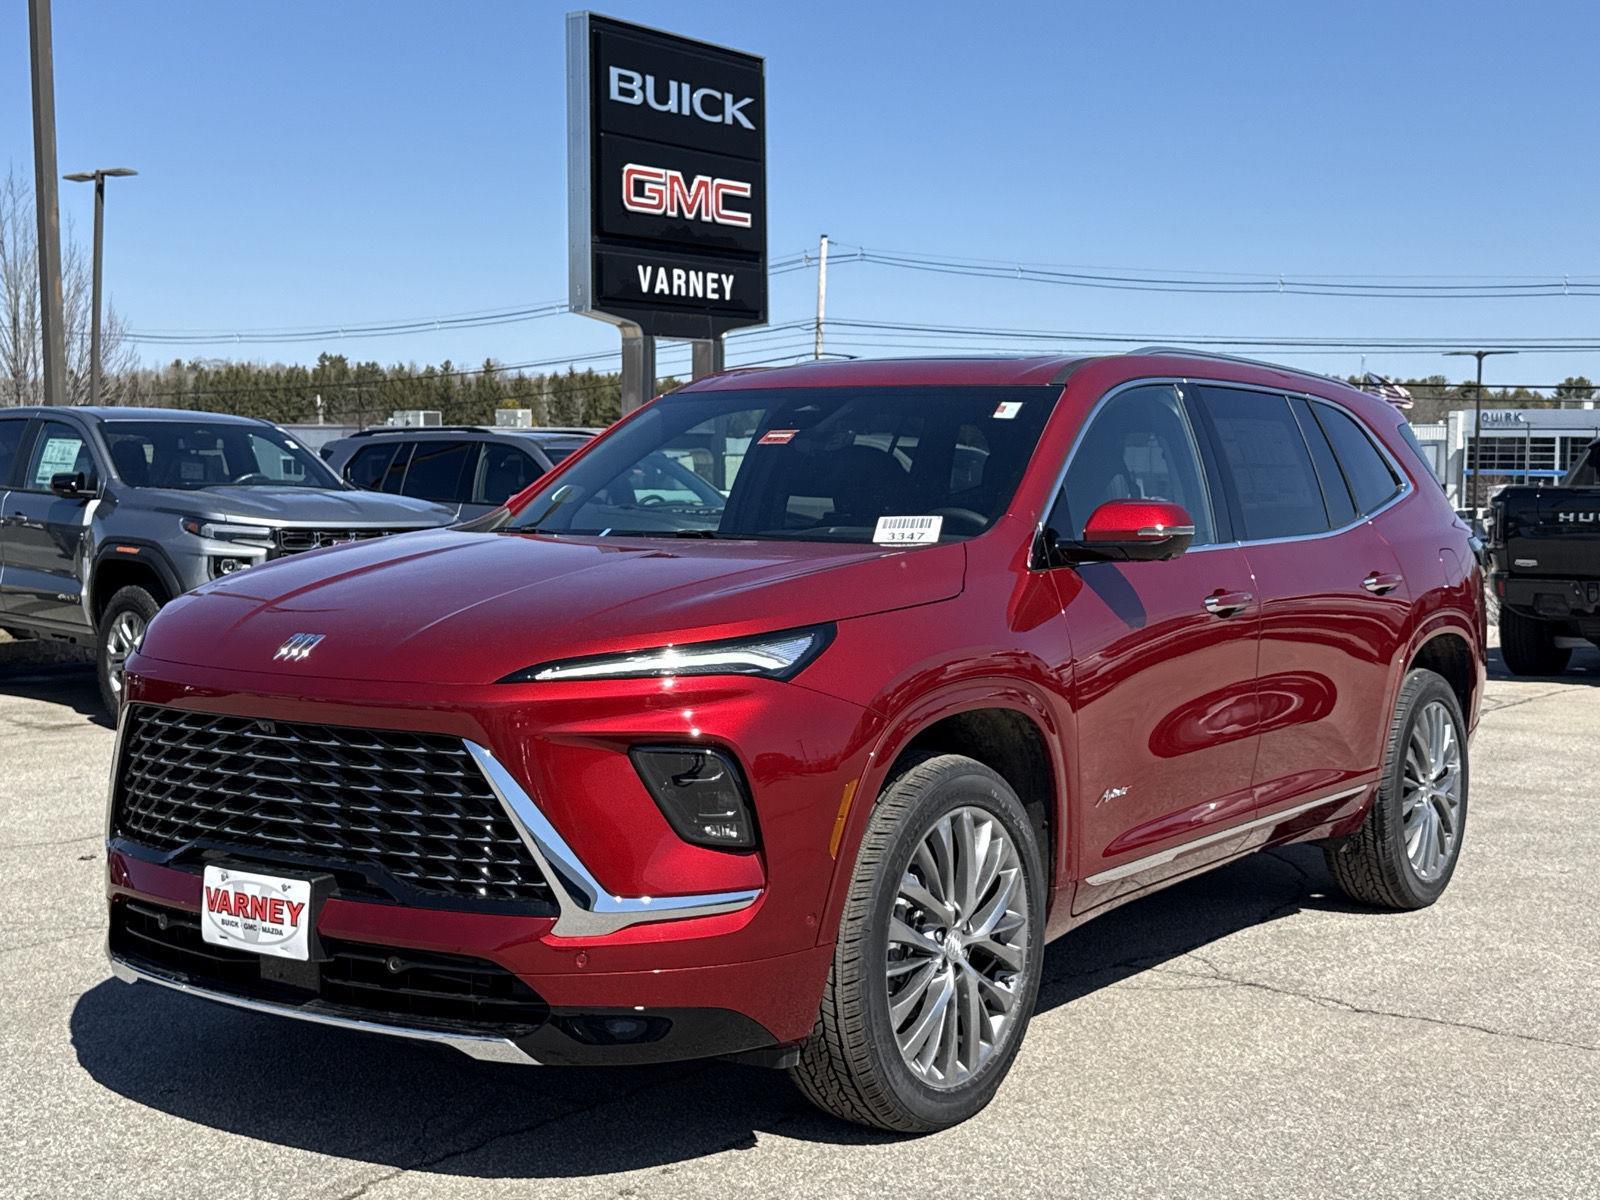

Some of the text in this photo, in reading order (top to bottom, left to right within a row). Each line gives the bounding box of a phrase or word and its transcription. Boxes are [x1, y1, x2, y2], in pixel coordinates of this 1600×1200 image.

[609, 66, 756, 130] BUICK
[622, 163, 752, 228] GMC
[637, 264, 735, 301] VARNEY
[1481, 412, 1523, 423] QUIRK
[1559, 512, 1600, 522] HU
[888, 532, 925, 541] 3347
[205, 886, 305, 927] VARNEY
[221, 918, 283, 936] BUICK GMC MAZDA
